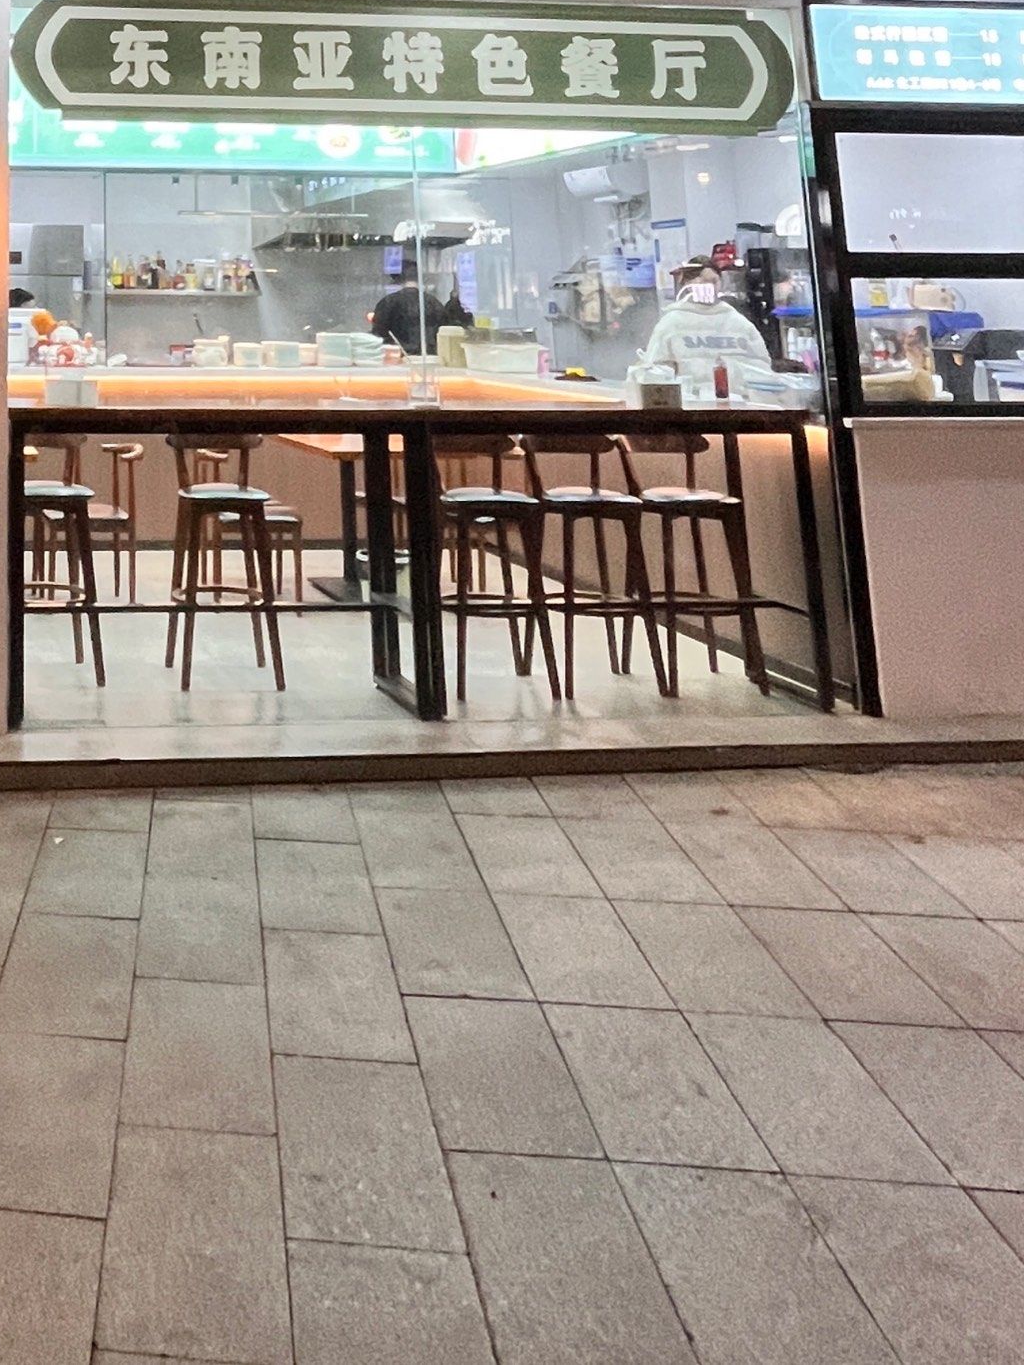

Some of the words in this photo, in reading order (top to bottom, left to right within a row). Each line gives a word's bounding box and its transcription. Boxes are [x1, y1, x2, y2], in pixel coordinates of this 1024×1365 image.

[108, 24, 707, 100] 东南亚特色餐厅
